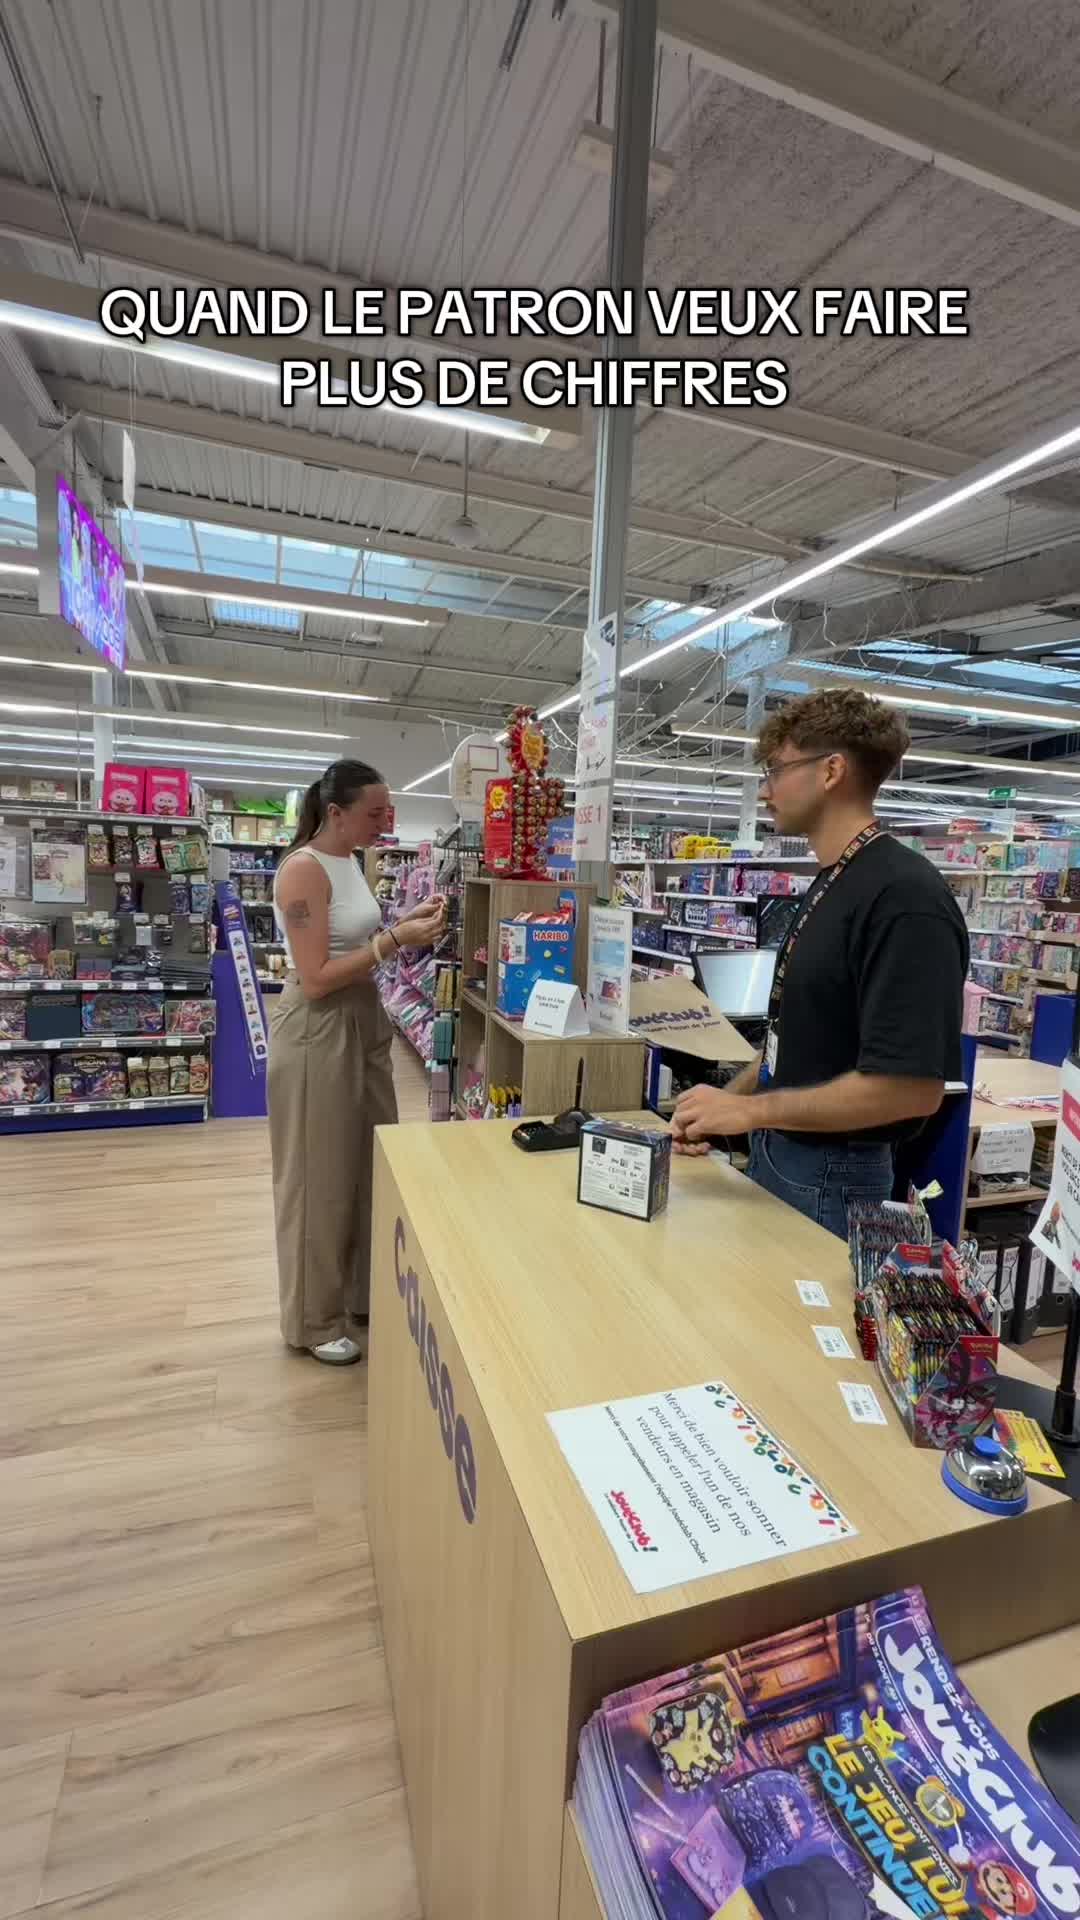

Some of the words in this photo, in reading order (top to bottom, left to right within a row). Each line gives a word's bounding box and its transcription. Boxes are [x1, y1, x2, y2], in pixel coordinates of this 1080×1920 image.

[533, 930, 569, 942] HARIBO
[394, 1215, 477, 1524] Caisse
[636, 1416, 673, 1464] vendeurs
[668, 1464, 684, 1479] en
[679, 1480, 721, 1534] magasin
[647, 1405, 673, 1430] pour
[667, 1431, 703, 1469] appeler
[715, 1494, 733, 1510] de
[727, 1511, 752, 1537] nos
[665, 1393, 688, 1419] Merci
[683, 1420, 697, 1433] de
[693, 1432, 716, 1457] bien
[713, 1457, 751, 1497] vouloir
[745, 1499, 788, 1547] sonner
[688, 1538, 709, 1564] Cholet
[866, 1632, 874, 1646] DU
[920, 1635, 1000, 1761] RENDEZ-VOUS
[807, 1746, 941, 1918] CONTINUE
[824, 1734, 865, 1778] LE
[855, 1782, 916, 1854] JEU,
[861, 1745, 875, 1764] LES
[873, 1765, 910, 1822] VACANCES
[908, 1816, 930, 1845] SONT
